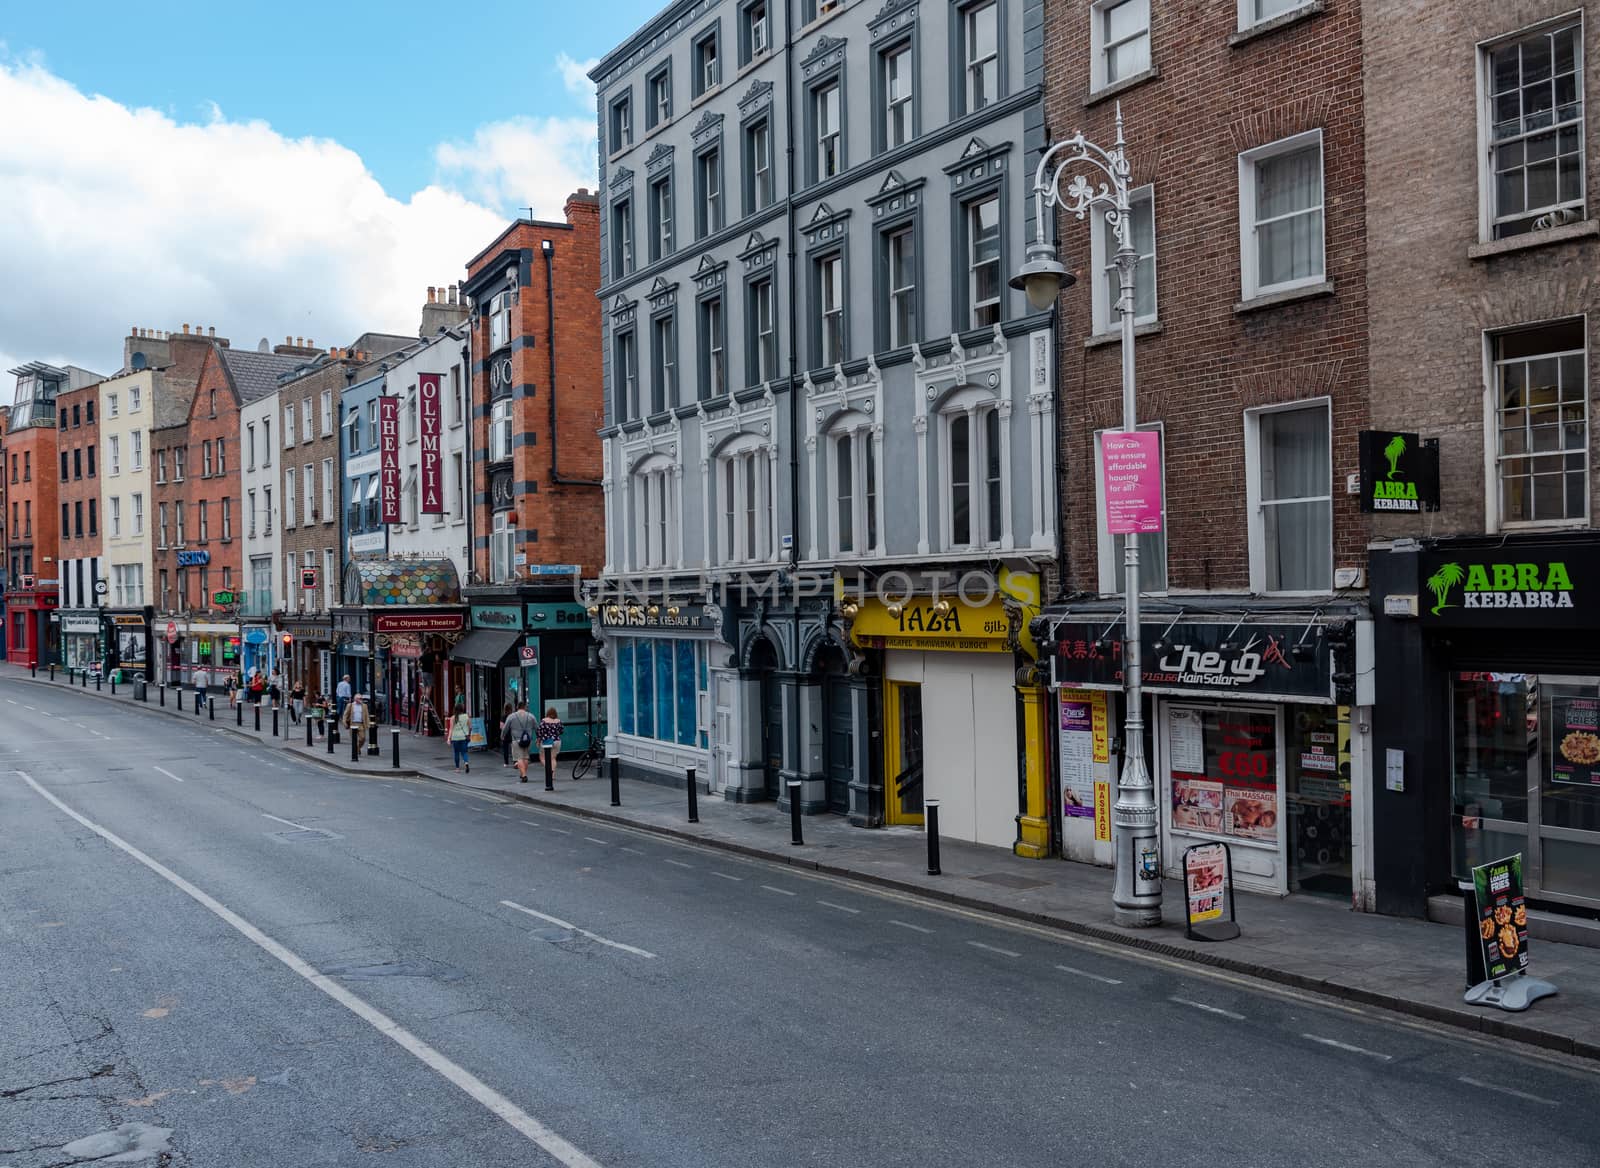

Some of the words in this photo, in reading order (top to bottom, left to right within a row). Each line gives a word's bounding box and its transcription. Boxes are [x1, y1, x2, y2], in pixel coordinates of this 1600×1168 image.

[422, 381, 438, 506] OLYMPIA
[1106, 442, 1124, 450] How
[382, 403, 397, 517] THEATRE
[1107, 462, 1147, 471] affordable
[1108, 474, 1139, 482] housing
[1374, 481, 1419, 499] ABRA
[1374, 498, 1419, 510] KEBABRA
[177, 550, 210, 567] SEIKO
[1463, 562, 1574, 591] ABRA
[1463, 591, 1574, 608] KEBABRA
[399, 620, 428, 628] Olympia
[899, 606, 962, 632] TAZA
[1218, 751, 1268, 778] €60
[1241, 791, 1275, 802] MASSAGE
[1098, 783, 1106, 839] MASSAGE
